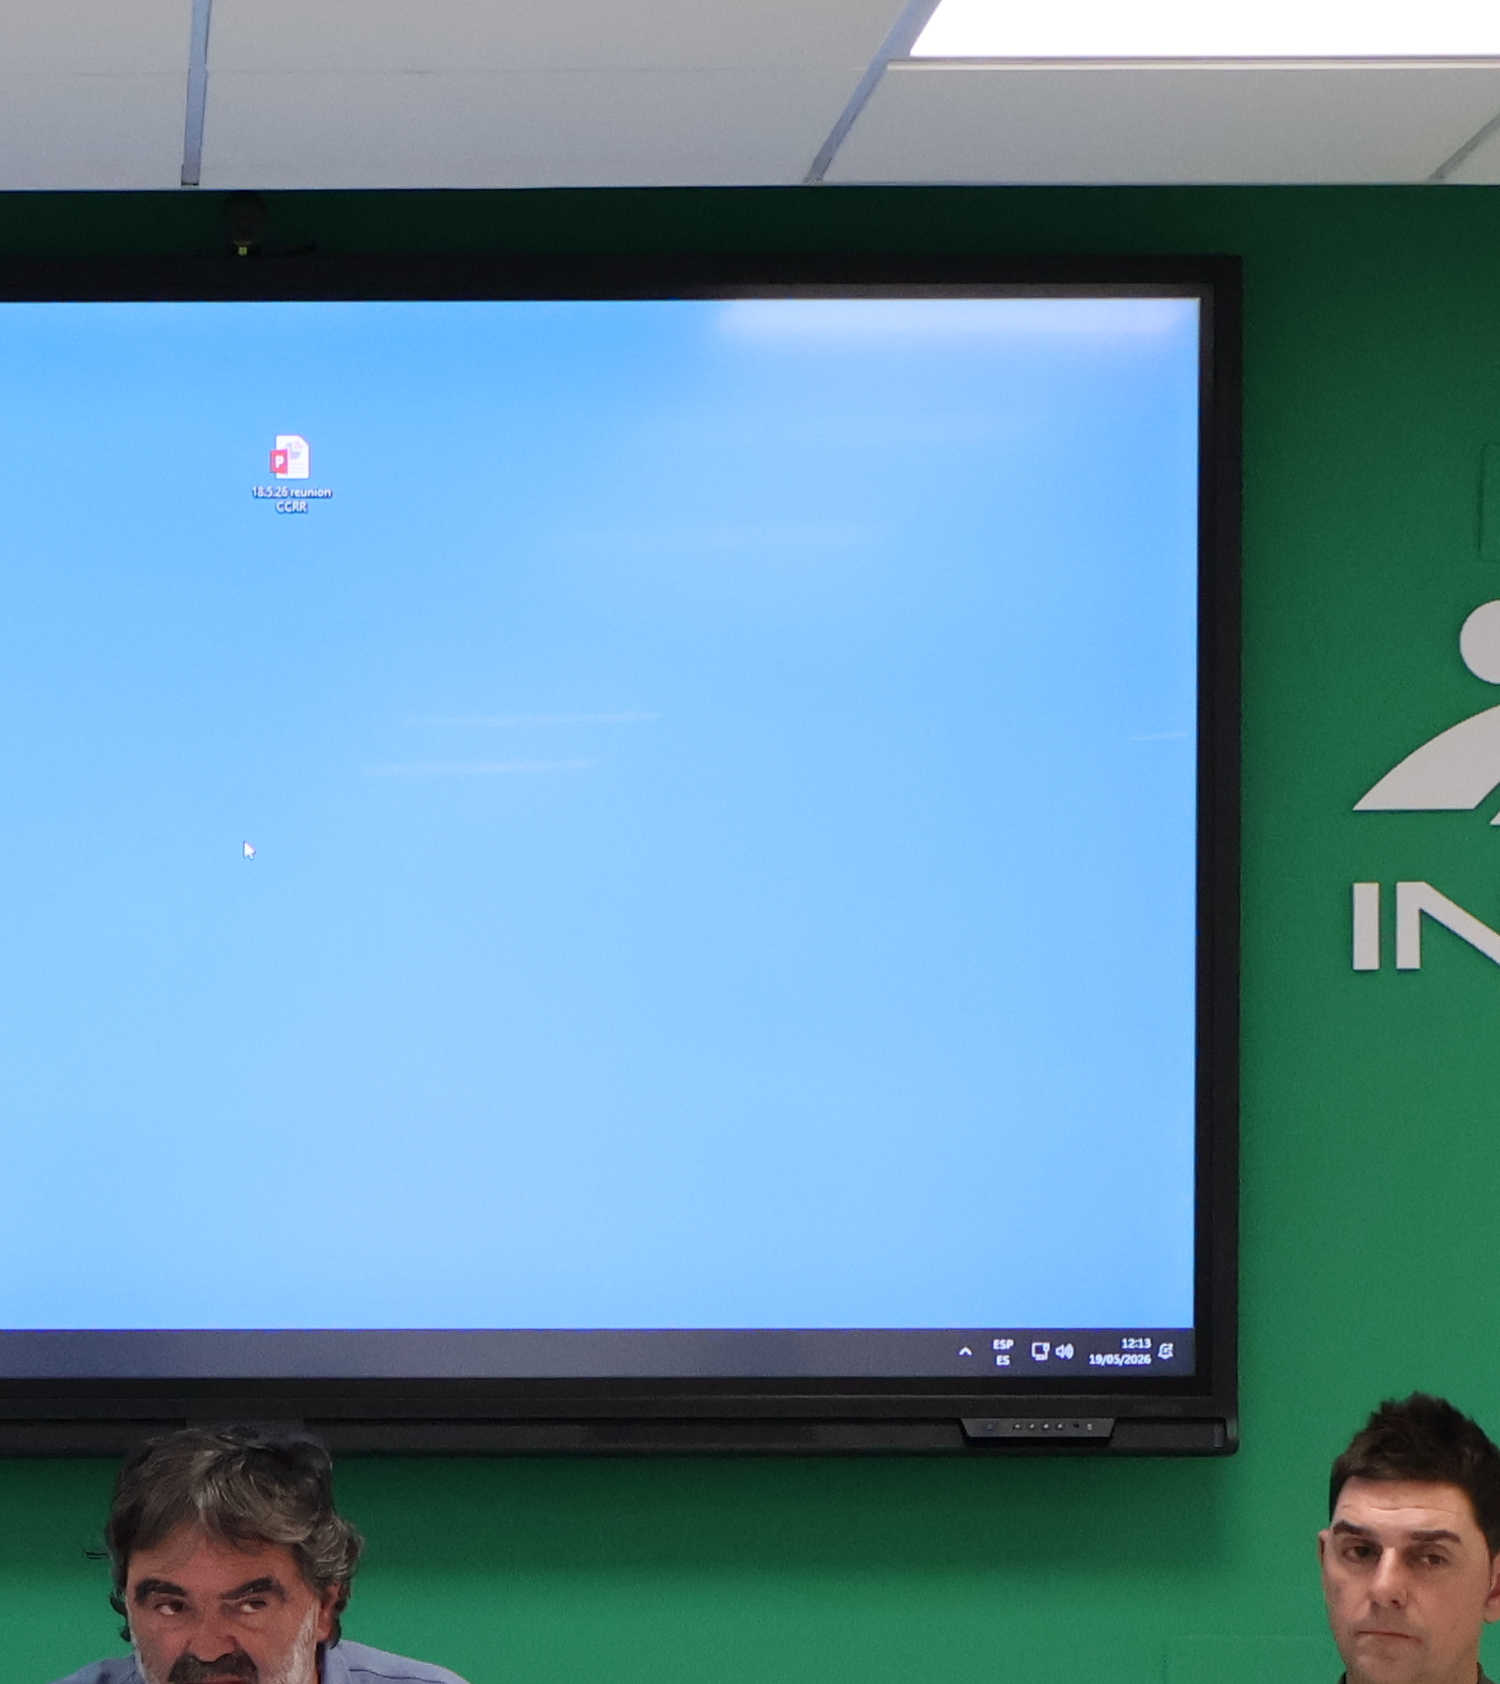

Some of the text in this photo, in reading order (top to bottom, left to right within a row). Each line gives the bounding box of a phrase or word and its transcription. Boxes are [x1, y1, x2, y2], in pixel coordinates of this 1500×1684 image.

[252, 486, 332, 498] 18.5.26 reunion
[276, 501, 307, 513] CCRR
[992, 1339, 1014, 1350] ESP
[1121, 1338, 1152, 1349] 12:13
[996, 1355, 1010, 1366] ES
[1089, 1354, 1152, 1367] 19/05/2026
